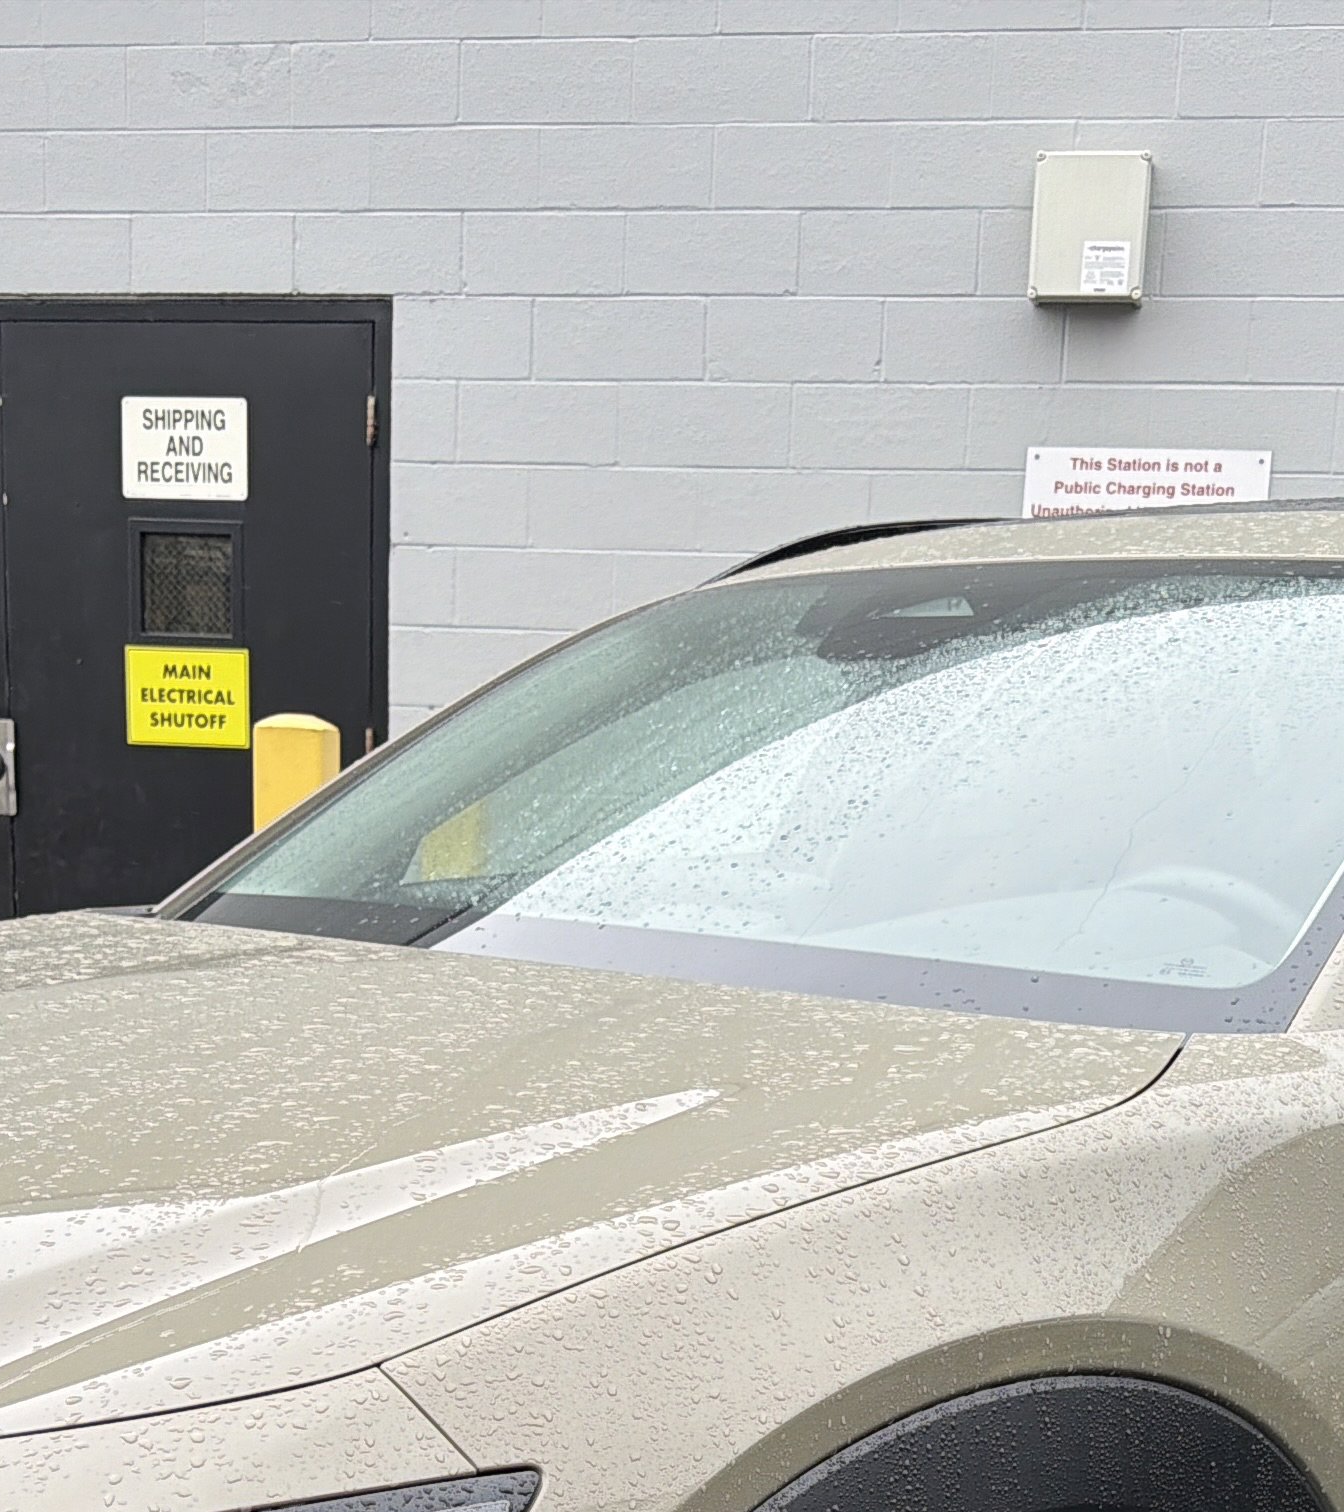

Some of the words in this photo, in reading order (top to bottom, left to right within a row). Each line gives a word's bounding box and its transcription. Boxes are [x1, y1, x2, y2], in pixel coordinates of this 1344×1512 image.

[142, 408, 226, 431] SHIPPING
[165, 435, 204, 457] AND
[137, 461, 233, 484] RECEIVING
[1070, 457, 1103, 472] This
[1106, 457, 1161, 472] Station
[1166, 458, 1179, 472] is
[1183, 459, 1209, 473] not
[1213, 461, 1223, 473] a
[1054, 481, 1101, 495] Public
[1106, 481, 1176, 499] Charging
[1180, 483, 1235, 497] Station
[162, 664, 211, 680] MAIN
[141, 687, 235, 705] ELECTRICAL
[150, 712, 227, 729] SHUTOFF
